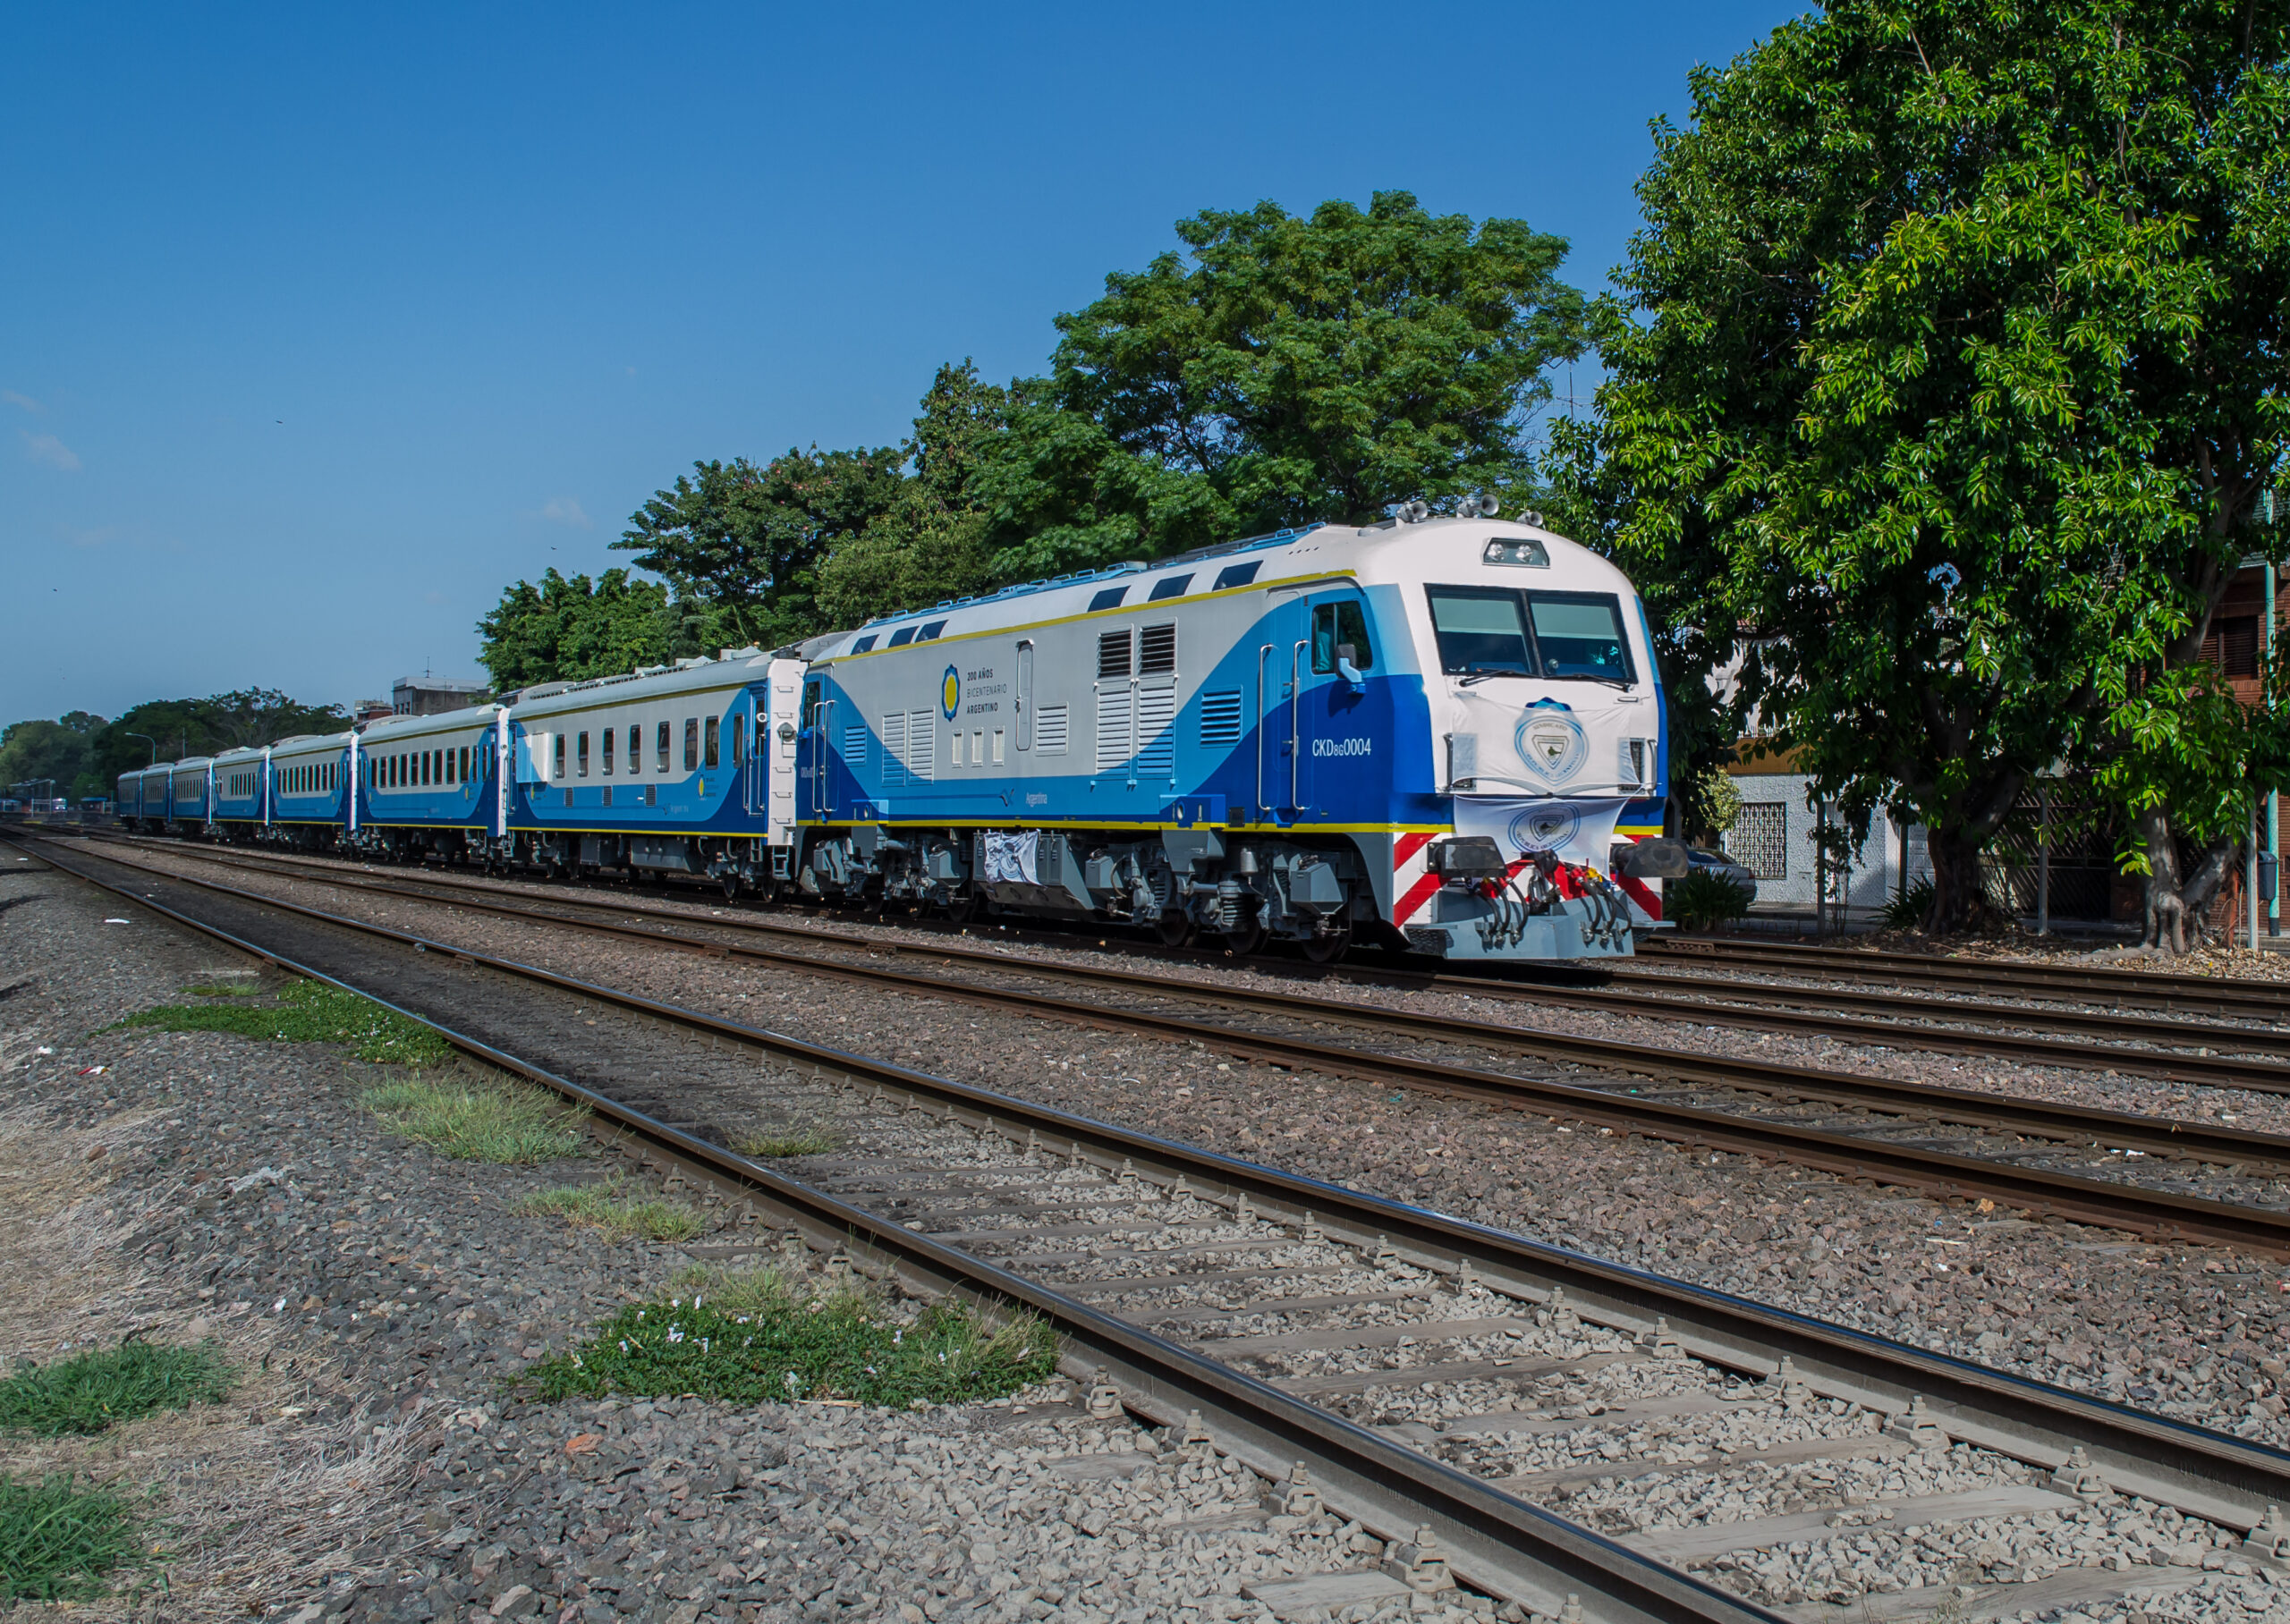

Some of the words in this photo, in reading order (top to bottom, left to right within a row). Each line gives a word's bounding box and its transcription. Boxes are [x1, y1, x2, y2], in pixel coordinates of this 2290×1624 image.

[967, 671, 977, 681] 200
[979, 667, 993, 680] AÑOS
[967, 683, 1007, 698] BICENTENARIO
[967, 702, 998, 714] ARGENTINO
[1312, 738, 1371, 757] CKD8G0004
[1026, 791, 1047, 808] Argentina
